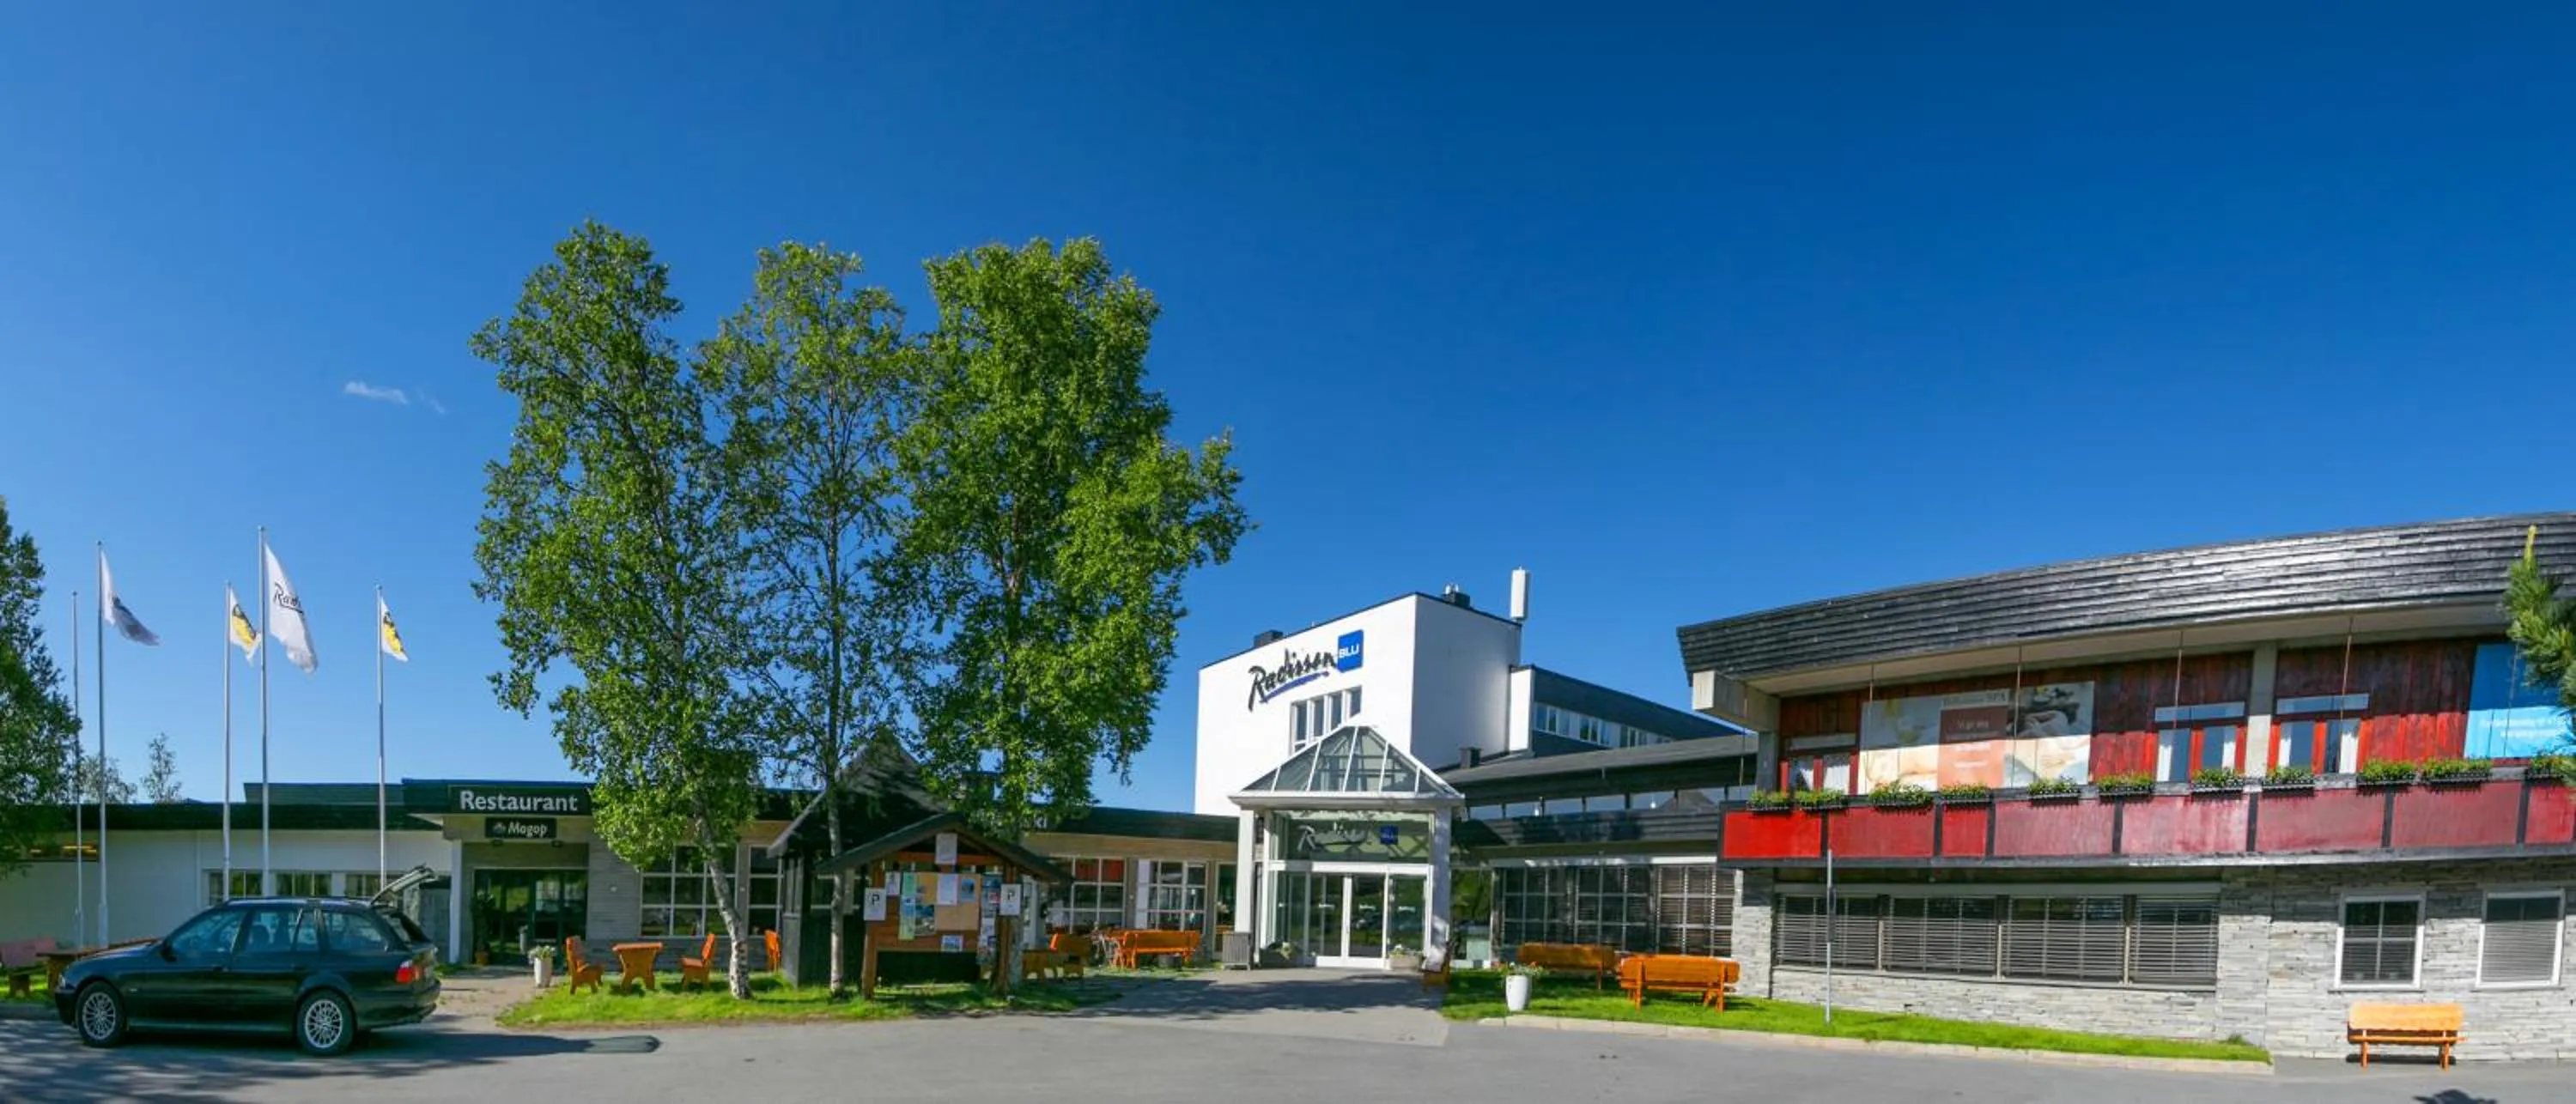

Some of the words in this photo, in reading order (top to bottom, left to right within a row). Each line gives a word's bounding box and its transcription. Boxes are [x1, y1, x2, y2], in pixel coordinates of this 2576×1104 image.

[1248, 647, 1339, 712] Radisson
[1340, 643, 1359, 658] BLU
[459, 790, 578, 811] Restaurant
[507, 822, 548, 838] Mogop
